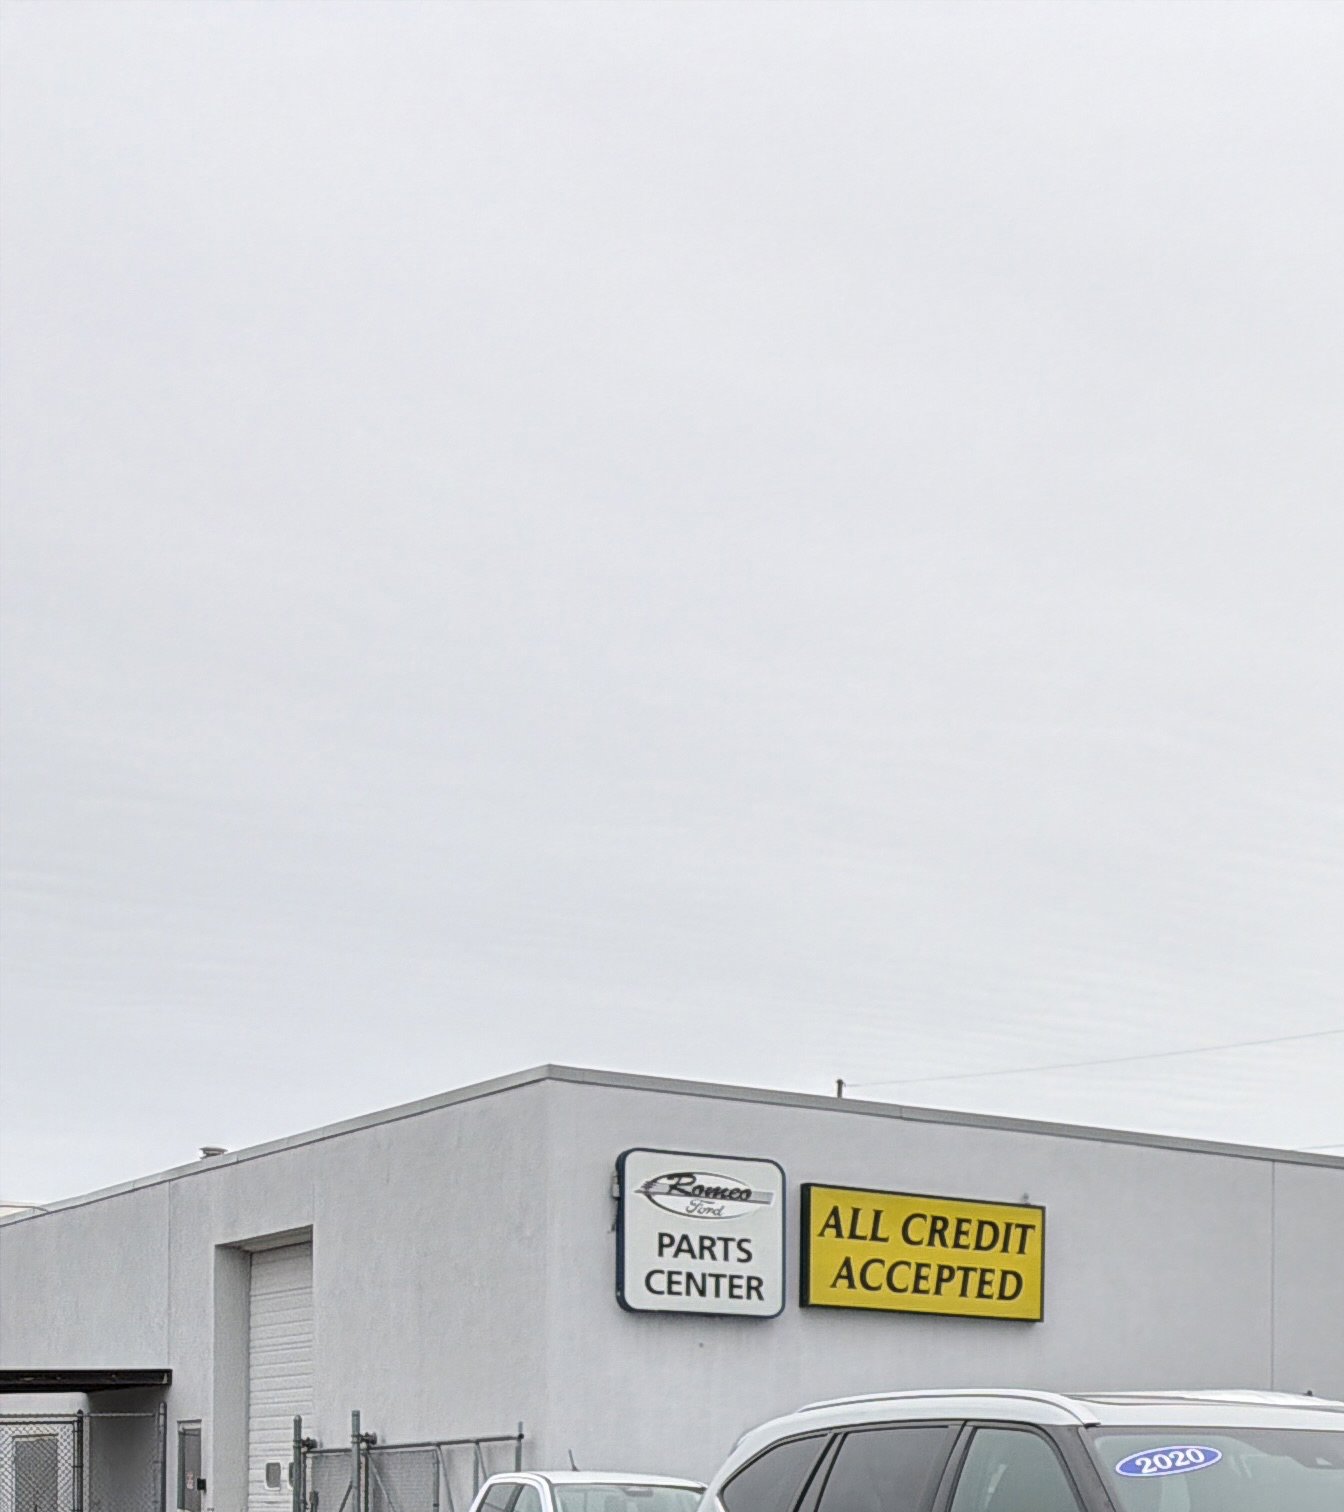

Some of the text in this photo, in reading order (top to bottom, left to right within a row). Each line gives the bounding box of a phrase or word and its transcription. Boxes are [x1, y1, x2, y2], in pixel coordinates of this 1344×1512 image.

[666, 1172, 753, 1201] Romeo
[685, 1199, 726, 1217] Ford
[817, 1204, 1036, 1255] ALL CREDIT
[657, 1231, 753, 1264] PARTS
[644, 1269, 765, 1301] CENTER
[829, 1256, 1024, 1301] ACCEPTED
[1134, 1447, 1206, 1474] 2020
